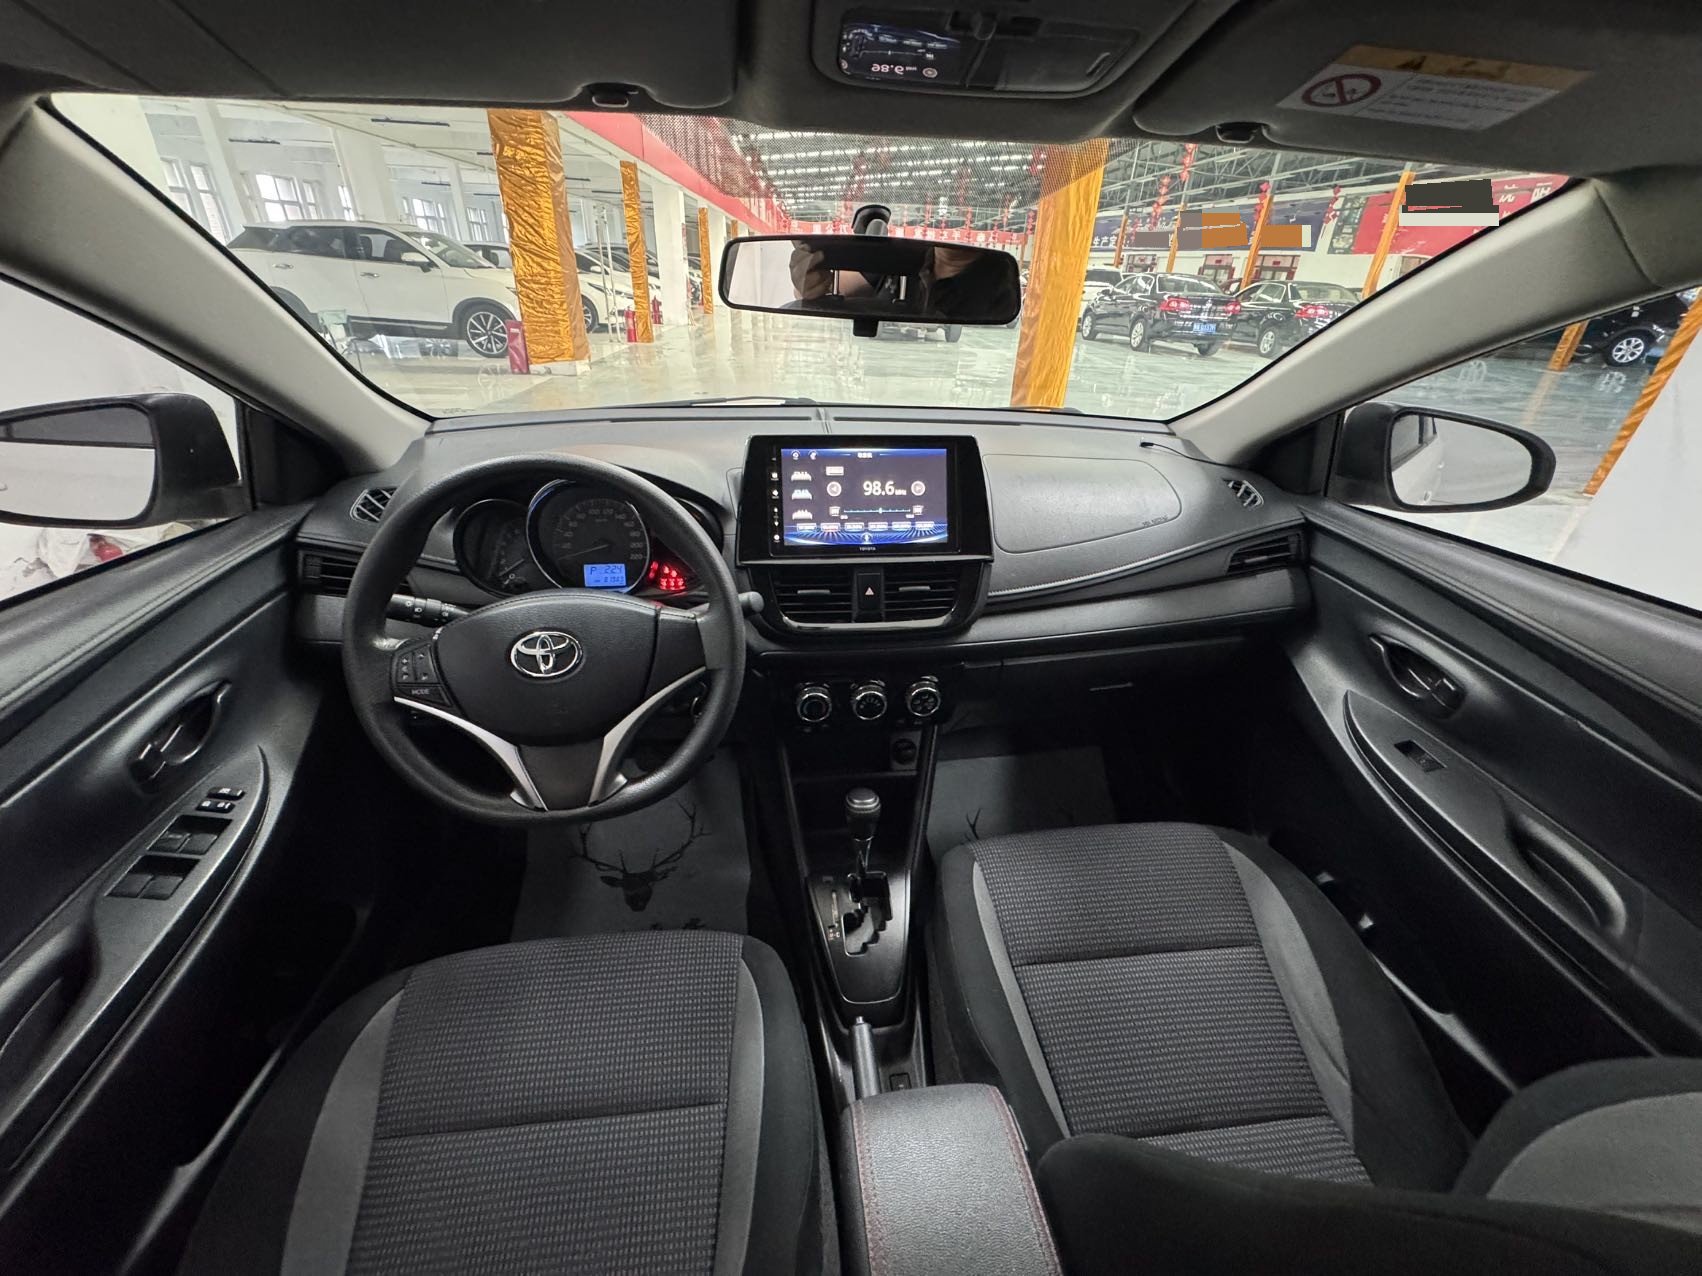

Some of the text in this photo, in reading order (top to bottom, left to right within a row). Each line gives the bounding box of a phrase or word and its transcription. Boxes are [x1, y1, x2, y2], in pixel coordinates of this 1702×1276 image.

[863, 480, 895, 496] 98.6
[590, 565, 622, 575] P 224
